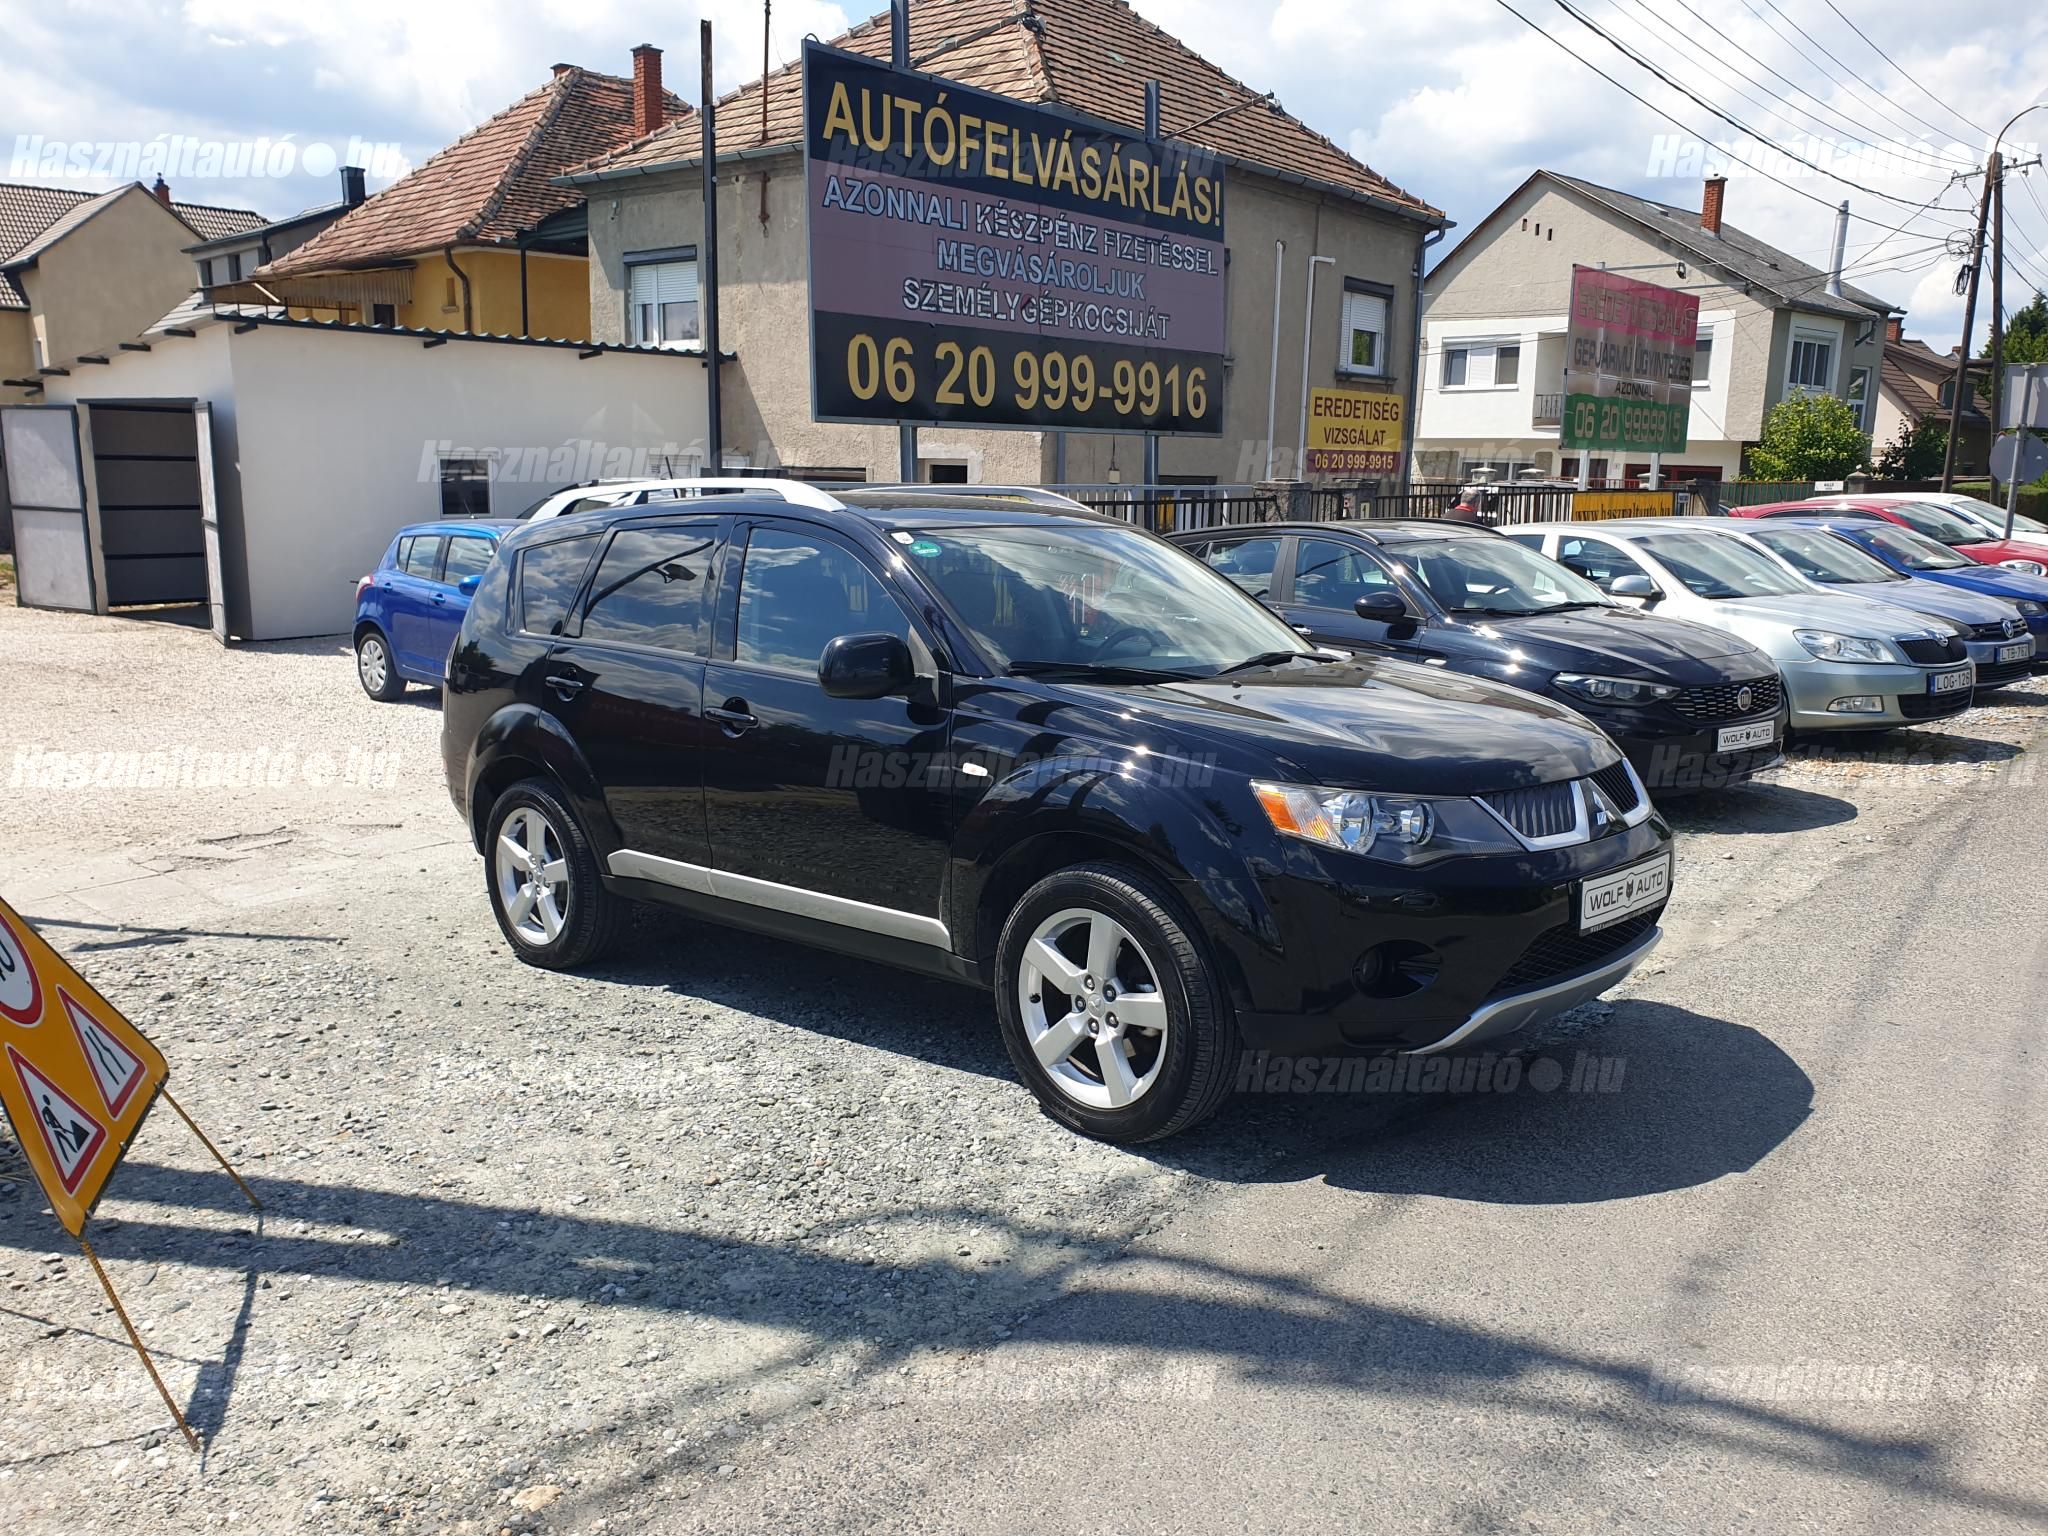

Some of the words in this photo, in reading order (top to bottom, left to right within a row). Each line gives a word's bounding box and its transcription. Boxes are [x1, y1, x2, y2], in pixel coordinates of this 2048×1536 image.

[822, 81, 1221, 228] AUTÓFELVÁSÁRLÁS!
[822, 176, 968, 232] AZONNALI
[976, 200, 1099, 255] KÉSZPÉNZ
[1103, 229, 1219, 277] FIZETÉSSEL
[937, 237, 1146, 301] MEGVÁSÁROLJUK
[902, 277, 1171, 341] SZEMÉLYGÉPKOCSIJÁT
[847, 332, 916, 403] 06
[935, 341, 996, 408] 20
[1013, 349, 1208, 420] 999-9916
[1314, 396, 1399, 421] EREDETISÉG
[1574, 402, 1596, 438] 06
[1600, 404, 1620, 440] 20
[1323, 424, 1387, 446] VIZSGÁLAT
[1315, 453, 1329, 469] 06
[1331, 453, 1345, 469] 20
[1347, 454, 1394, 469] 999-9915
[1936, 671, 1970, 690] LOG-126
[1722, 732, 1745, 744] WOLF
[1752, 728, 1771, 739] AUTO
[1589, 885, 1624, 911] WOLF
[1635, 870, 1663, 895] AUTO
